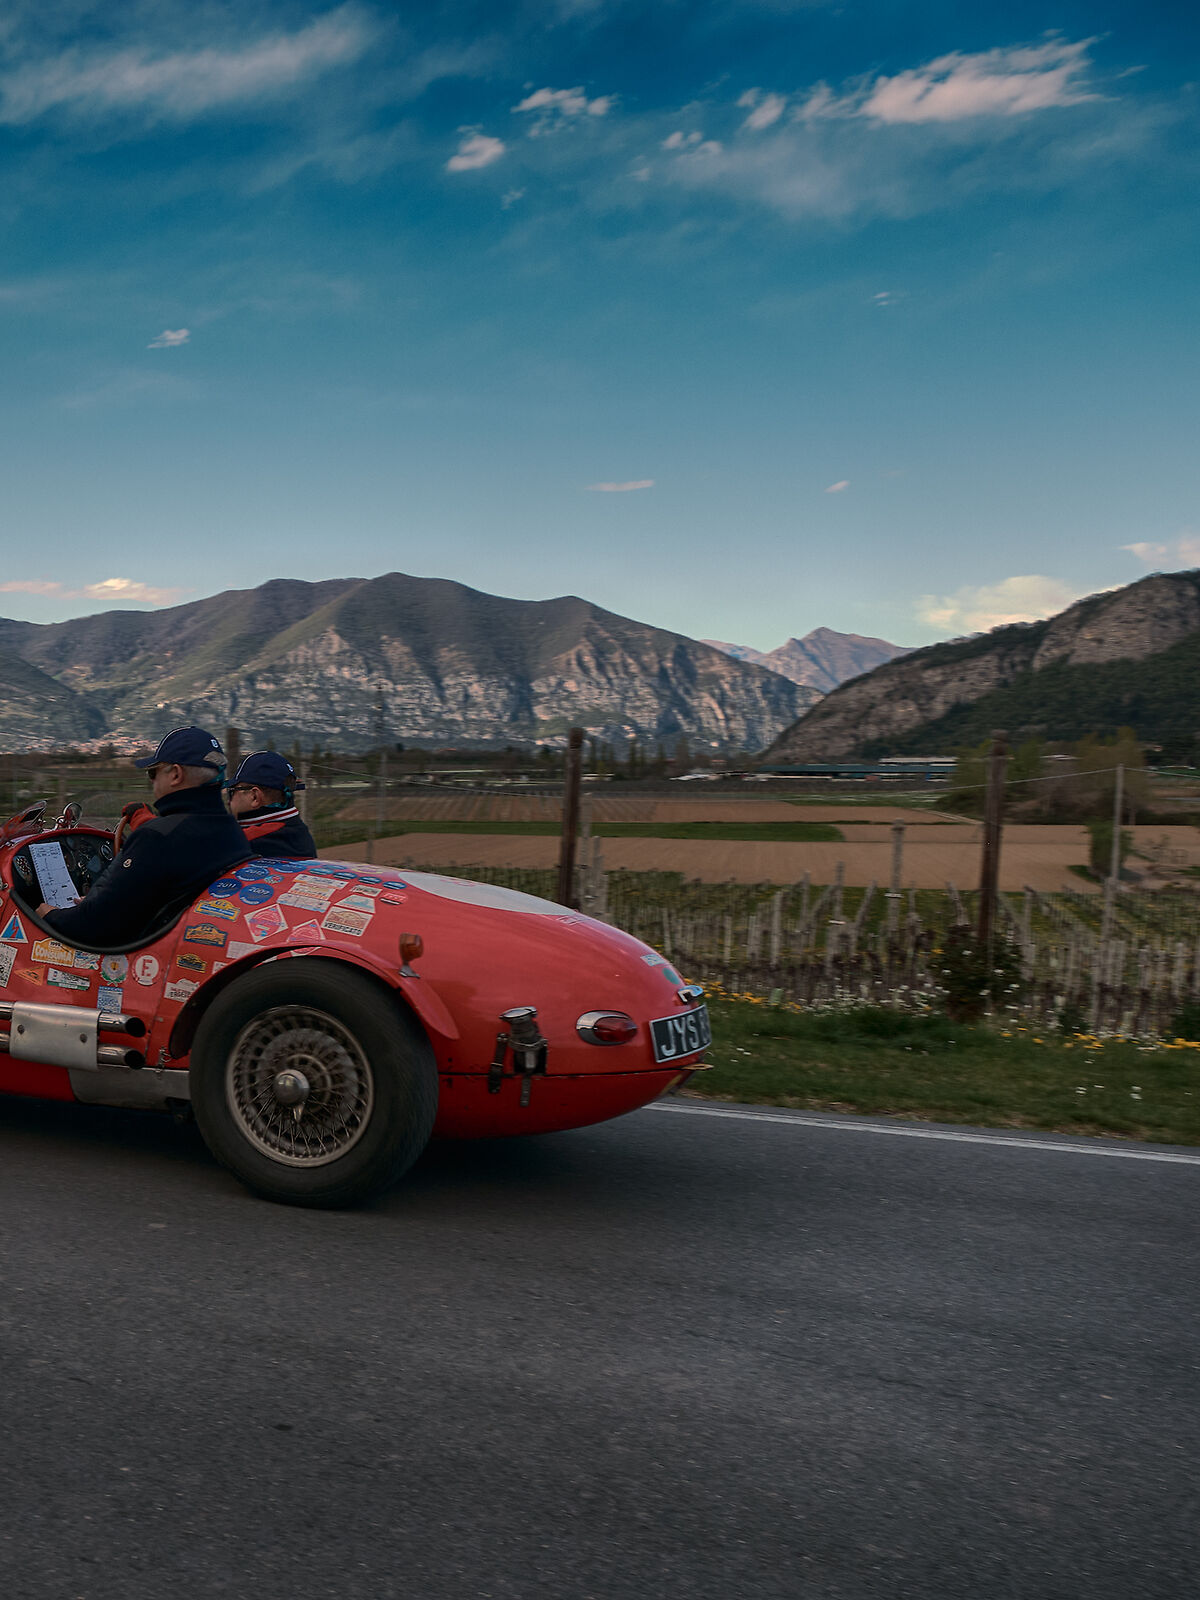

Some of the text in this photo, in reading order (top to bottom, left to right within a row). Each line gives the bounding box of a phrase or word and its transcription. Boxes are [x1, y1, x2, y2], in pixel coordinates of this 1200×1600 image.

[324, 921, 362, 936] VERIFICATO
[142, 958, 153, 977] E
[661, 1013, 700, 1056] JYS
